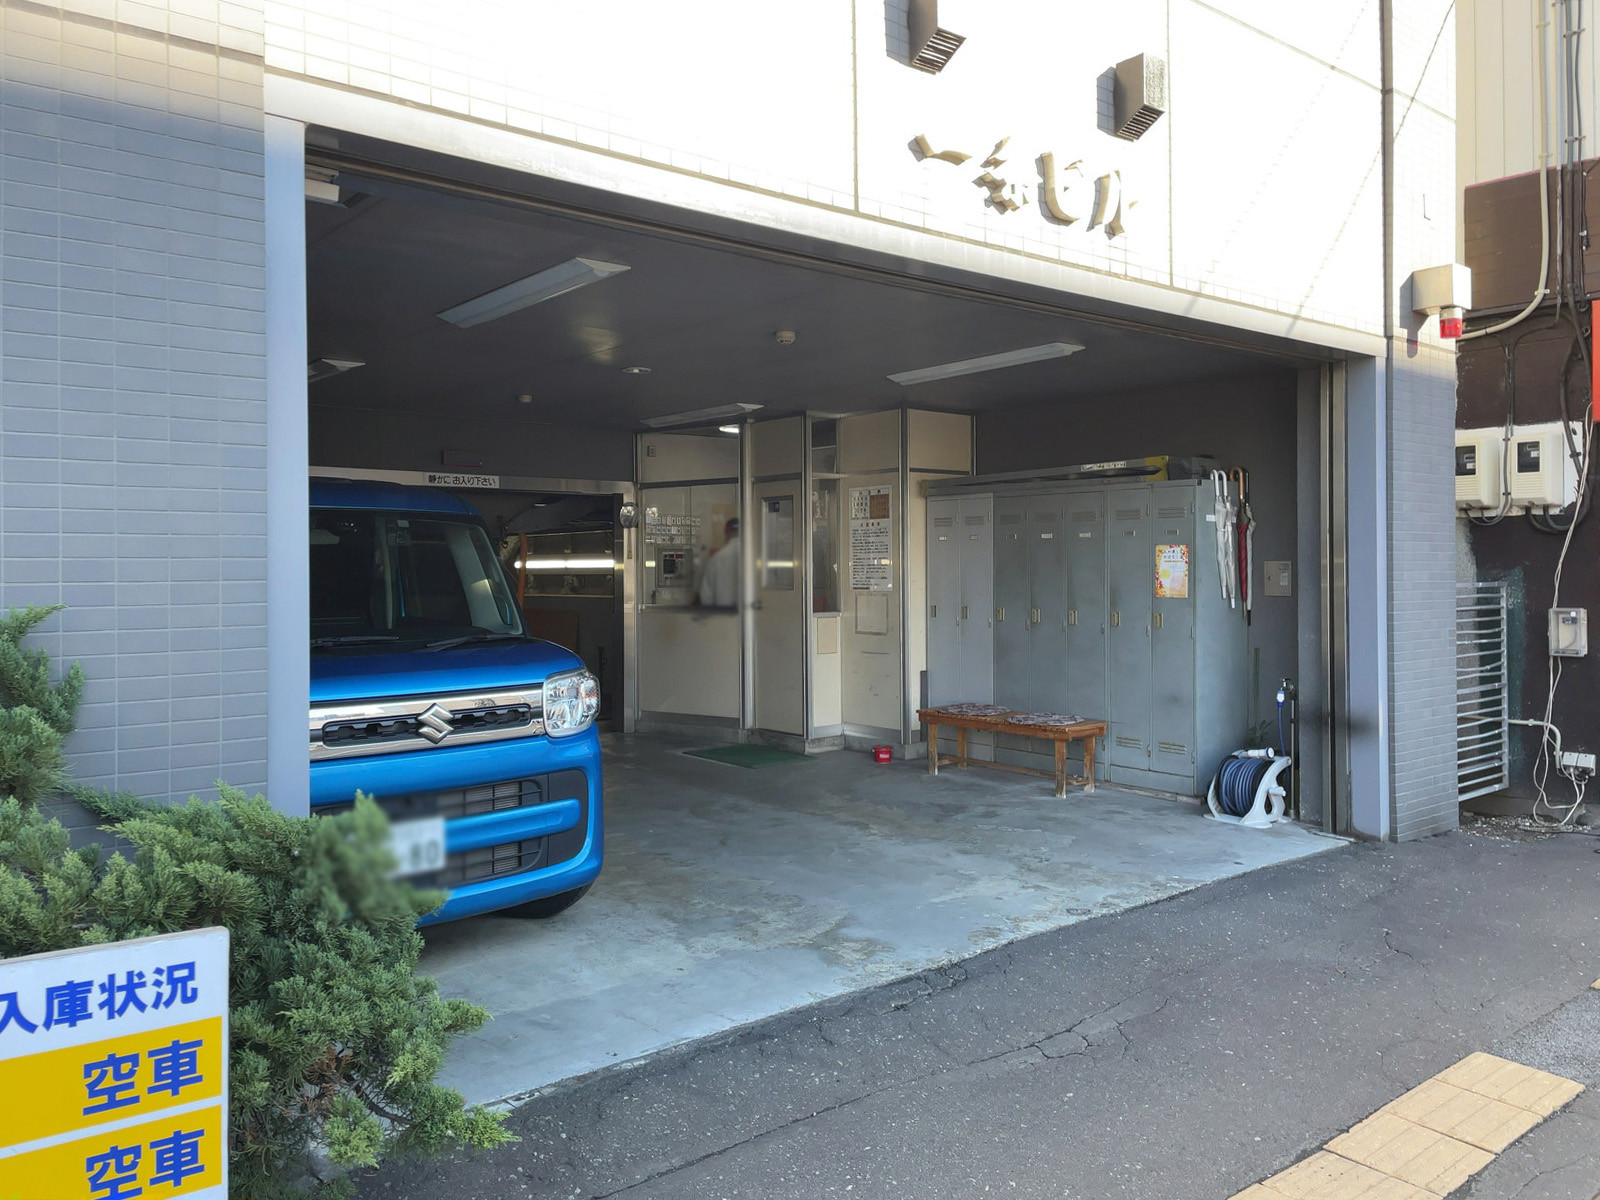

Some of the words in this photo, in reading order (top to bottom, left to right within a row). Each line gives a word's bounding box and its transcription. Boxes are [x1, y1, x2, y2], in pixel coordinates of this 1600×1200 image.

[0, 961, 198, 1035] 入庫状況
[83, 1039, 203, 1116] 空車
[85, 1129, 205, 1200] 空車
